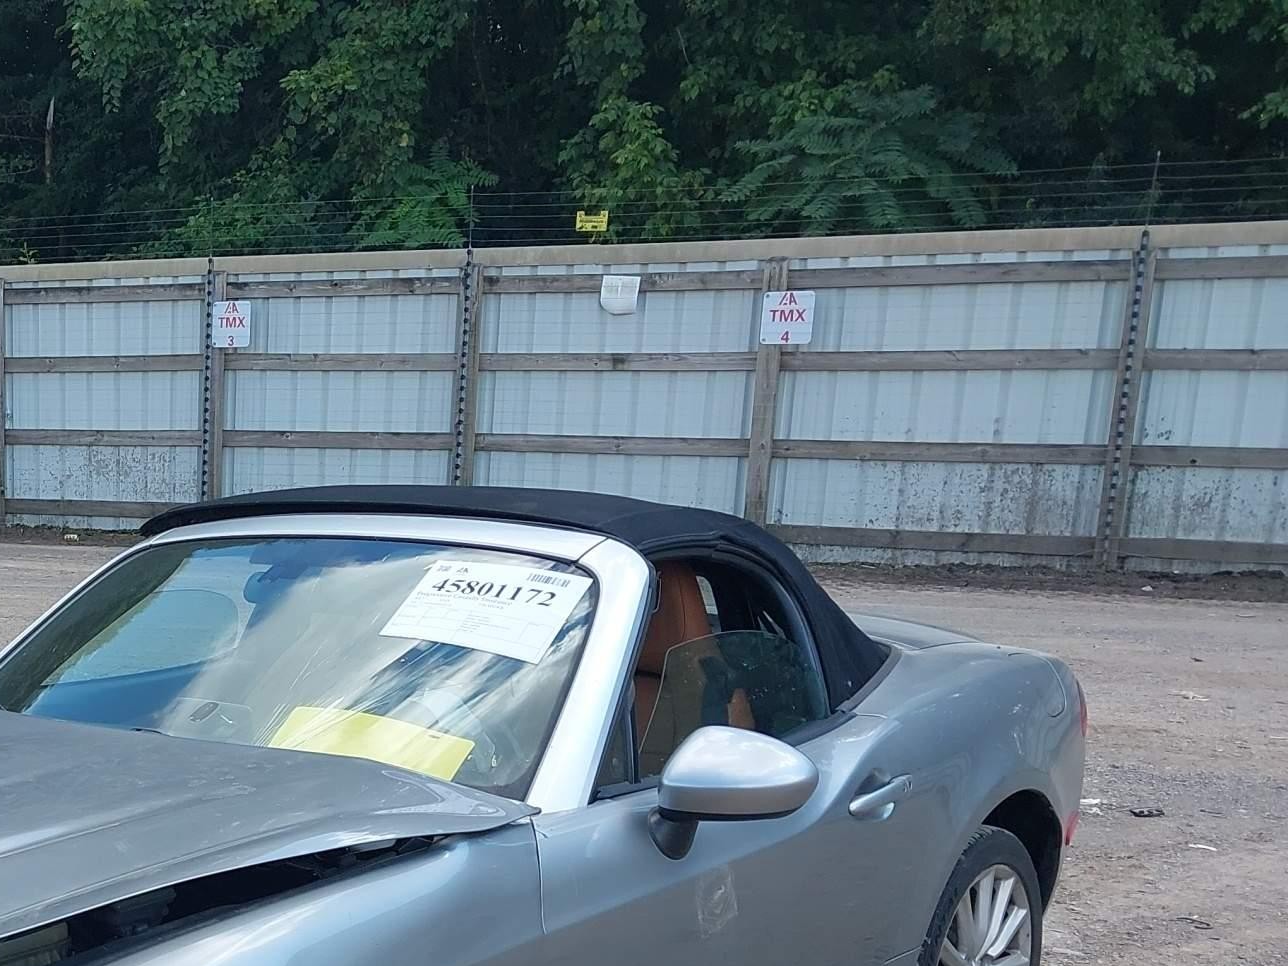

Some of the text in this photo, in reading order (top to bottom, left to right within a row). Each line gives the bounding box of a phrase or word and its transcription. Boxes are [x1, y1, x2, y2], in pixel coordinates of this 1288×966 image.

[769, 308, 807, 322] TMX
[217, 316, 246, 329] TMX
[227, 335, 235, 347] 3
[780, 330, 790, 343] 4
[431, 577, 557, 608] 45801172
